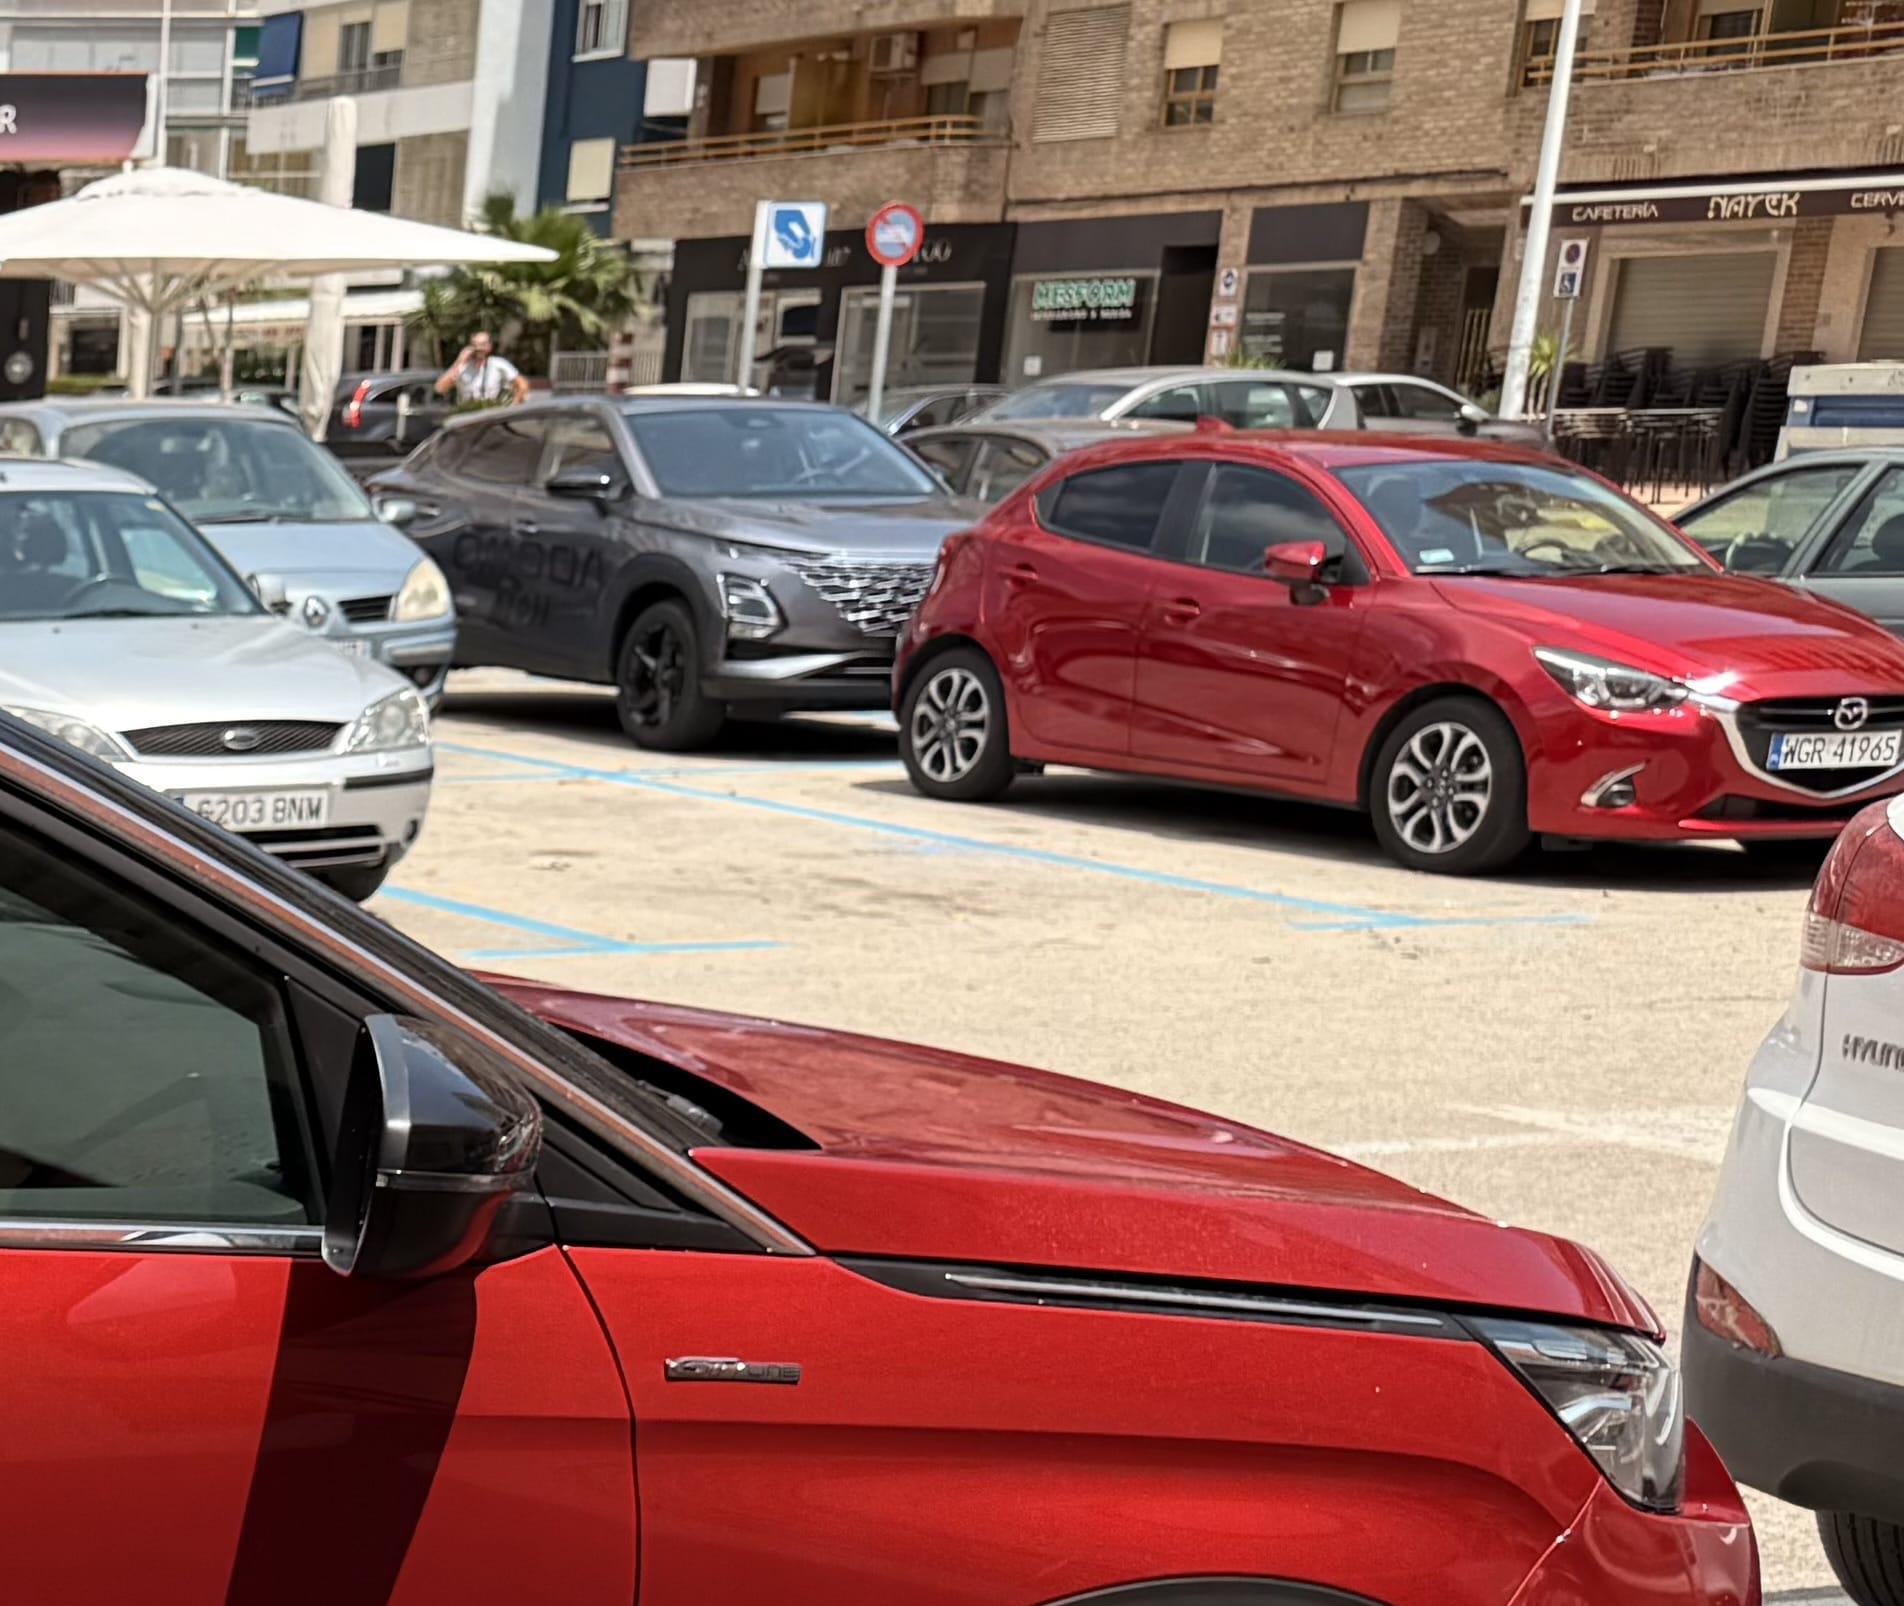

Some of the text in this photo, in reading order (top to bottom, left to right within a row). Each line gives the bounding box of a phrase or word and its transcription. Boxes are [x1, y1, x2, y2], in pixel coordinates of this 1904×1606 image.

[1783, 734, 1897, 765] WGR 41965
[1842, 1033, 1904, 1072] HYUN
